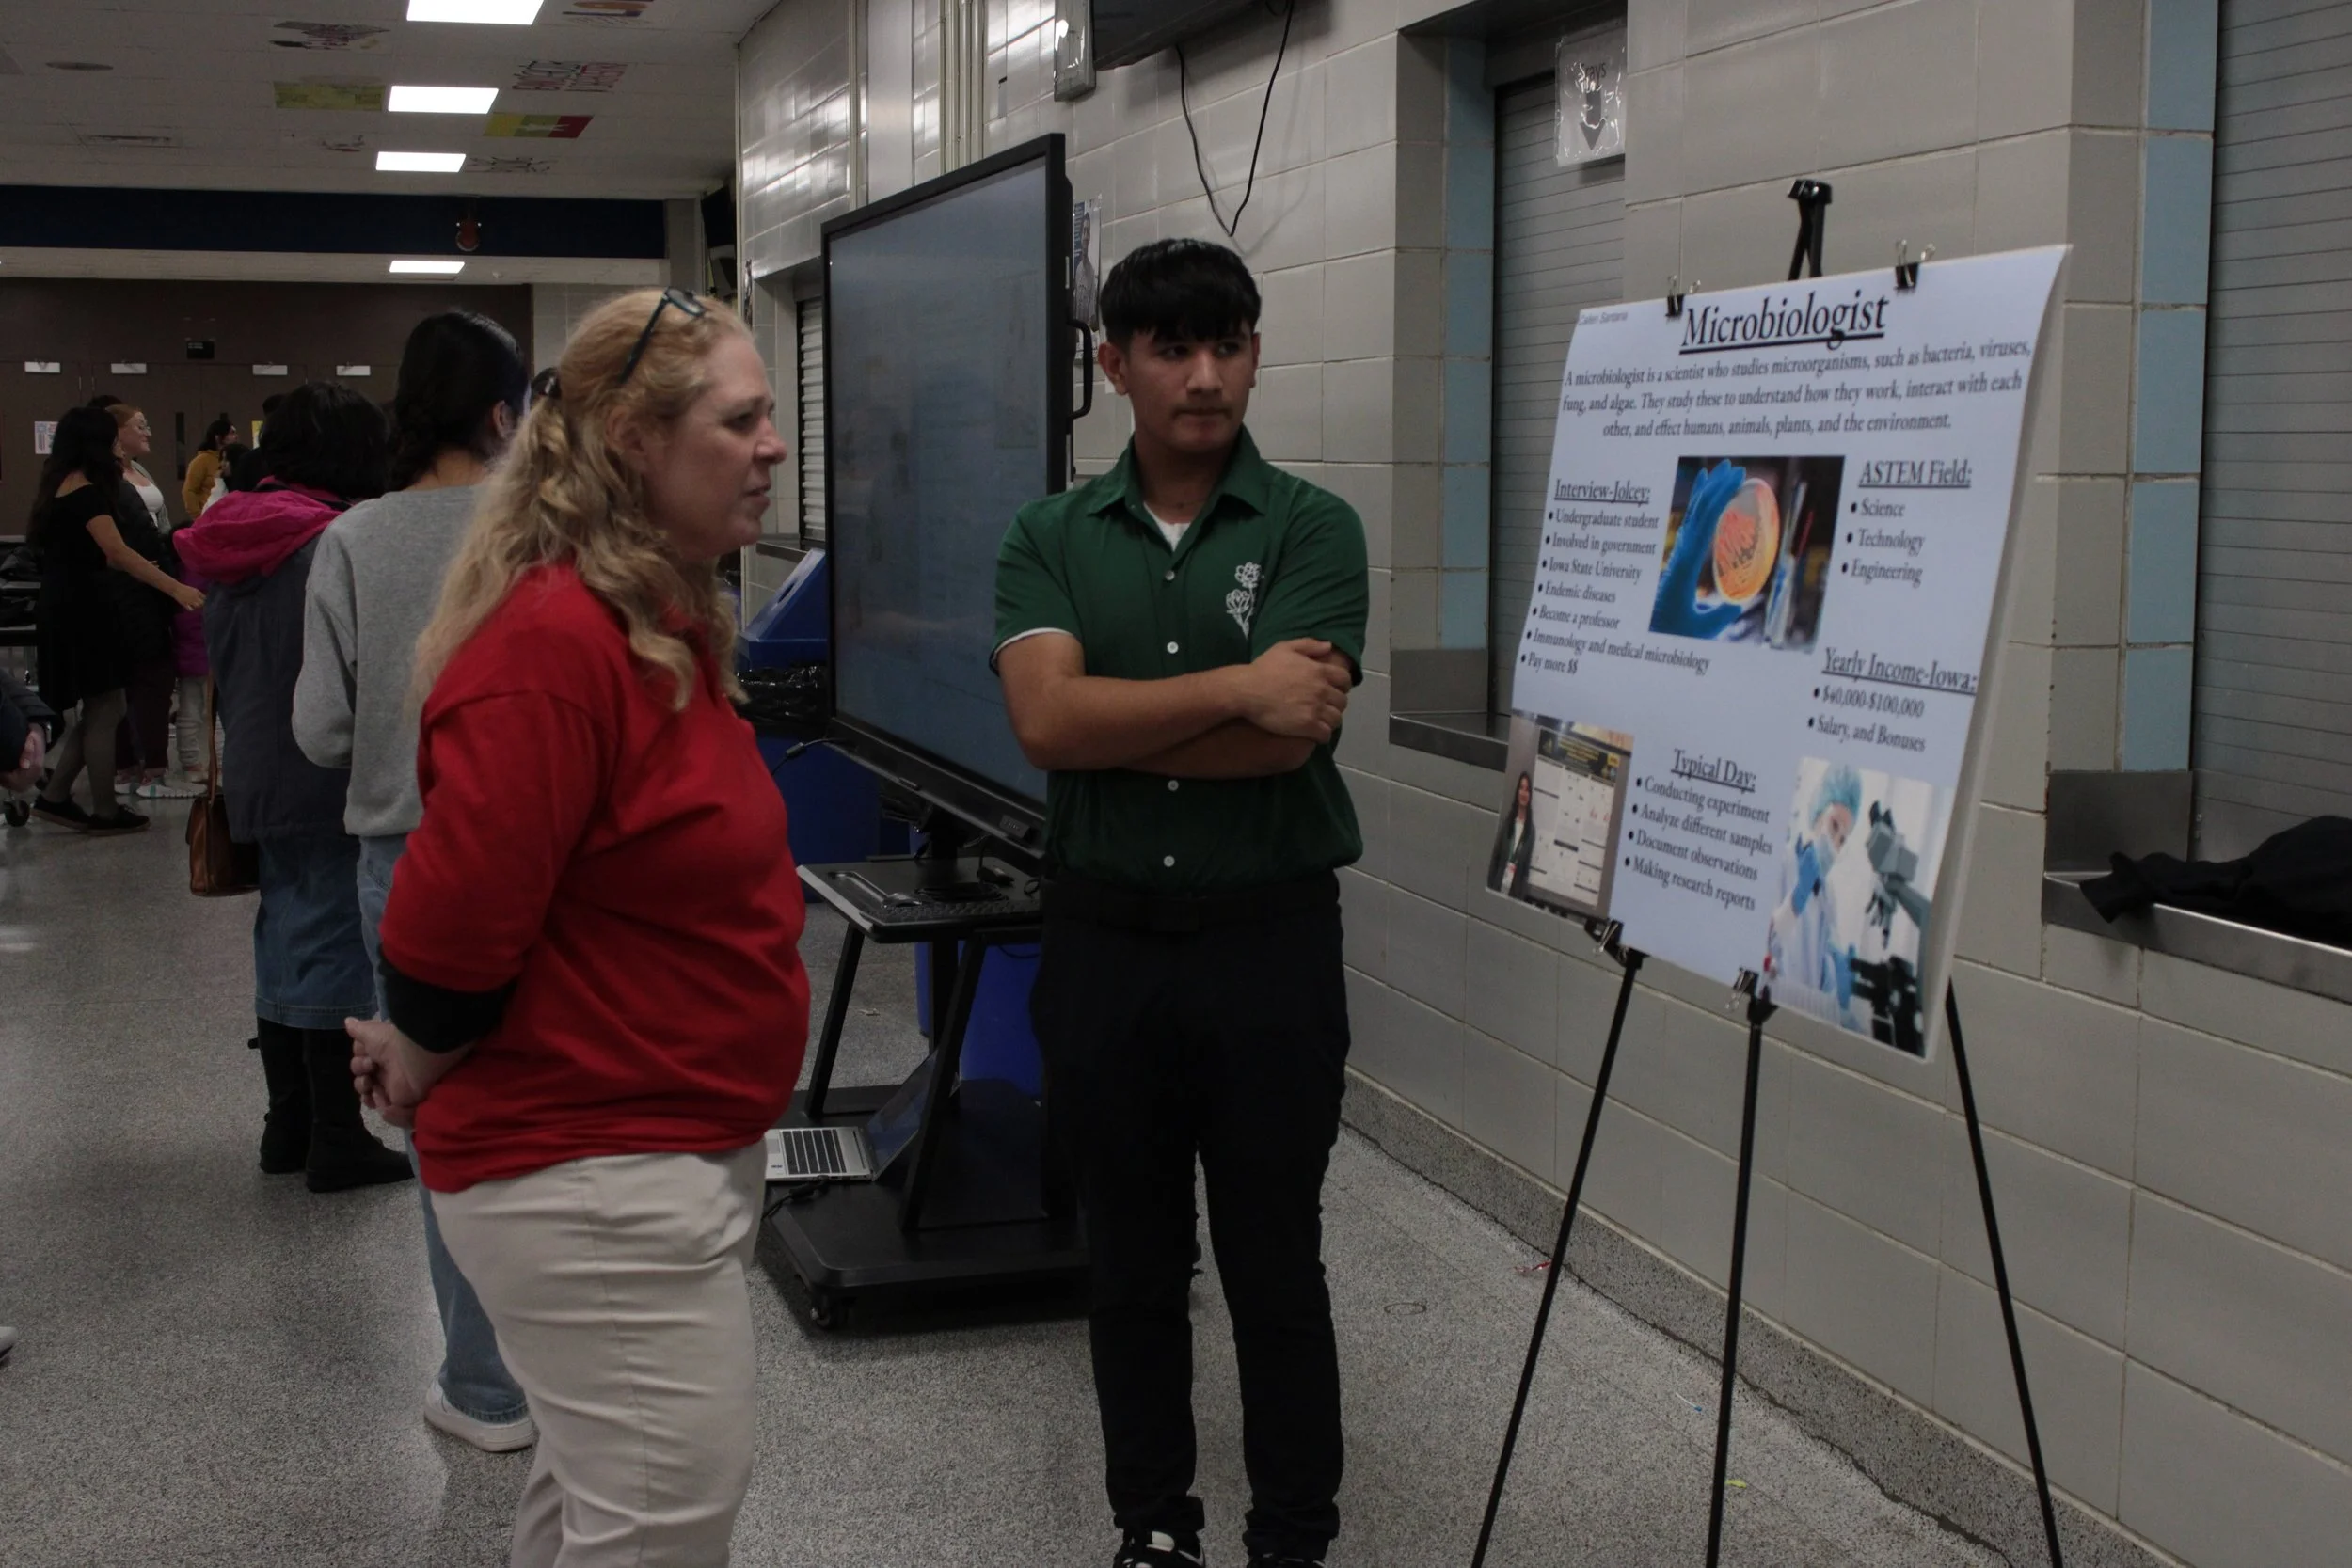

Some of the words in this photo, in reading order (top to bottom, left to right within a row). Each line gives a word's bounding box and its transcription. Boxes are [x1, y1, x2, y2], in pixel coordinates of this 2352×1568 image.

[1681, 289, 1889, 351] Microbiologist
[1565, 370, 1573, 386] A
[1575, 366, 1645, 389] microbiologist
[1646, 367, 1655, 382] is
[1657, 371, 1663, 382] a
[1664, 363, 1705, 381] scientist
[1708, 361, 1729, 377] who
[1732, 357, 1769, 375] studies
[1772, 351, 1870, 378] microorganisms,
[1874, 347, 1904, 368] such
[1908, 351, 1919, 366] as
[1922, 341, 1975, 363] bacteria,
[1979, 338, 2031, 358] viruses,
[1588, 394, 1608, 411] and
[1610, 393, 1637, 416] algae.
[1641, 392, 1664, 415] They
[1667, 390, 1692, 415] study
[1696, 389, 1721, 406] these
[1724, 390, 1735, 405] to
[1739, 384, 1801, 405] understand
[1804, 383, 1830, 403] how
[1835, 381, 1862, 407] they
[1866, 379, 1902, 402] work,
[1906, 378, 1954, 398] interact
[1957, 371, 1987, 394] with
[1990, 368, 2022, 392] each
[1602, 420, 1632, 438] other,
[1634, 418, 1652, 436] and
[1655, 417, 1681, 436] effect
[1683, 417, 1724, 437] humans,
[1728, 415, 1771, 437] animals,
[1774, 414, 1814, 439] plants,
[1817, 412, 1839, 433] and
[1844, 412, 1863, 432] the
[1867, 412, 1951, 433] environment.
[1927, 459, 1973, 487] Field:
[1556, 508, 1622, 530] Undergraduate
[1624, 513, 1660, 530] student
[1860, 497, 1906, 517] Science
[1552, 531, 1588, 551] Involved
[1591, 535, 1600, 551] in
[1601, 539, 1658, 556] government
[1858, 527, 1925, 556] Technology
[1549, 556, 1568, 573] Iowa
[1572, 557, 1592, 575] State
[1595, 560, 1642, 585] University
[1851, 558, 1923, 589] Engineering
[1545, 580, 1580, 600] Endemic
[1582, 582, 1616, 603] diseases
[1538, 606, 1570, 624] Become
[1572, 613, 1578, 625] a
[1578, 610, 1620, 630] professor
[1528, 651, 1543, 673] Pay
[1544, 657, 1566, 673] more
[1566, 658, 1578, 675] $$
[1533, 627, 1586, 657] Immunology
[1588, 638, 1606, 655] and
[1607, 641, 1644, 660] medical
[1645, 645, 1711, 676] microbiology
[1823, 646, 1866, 682] Yearly
[1867, 652, 1978, 695] Income-Iowa:
[1817, 713, 1850, 743] Salary,
[1853, 722, 1876, 743] and
[1876, 724, 1926, 752] Bonuses
[1673, 748, 1722, 781] Typical
[1723, 758, 1757, 794] Day:
[1645, 775, 1706, 813] Conducting
[1707, 797, 1771, 824] experiment
[1640, 803, 1680, 832] Analyze
[1681, 815, 1728, 840] different
[1729, 832, 1772, 856] samples
[1636, 829, 1689, 861] Document
[1690, 844, 1757, 881] observations
[1632, 854, 1671, 889] Making
[1672, 874, 1713, 896] research
[1715, 887, 1756, 911] reports
